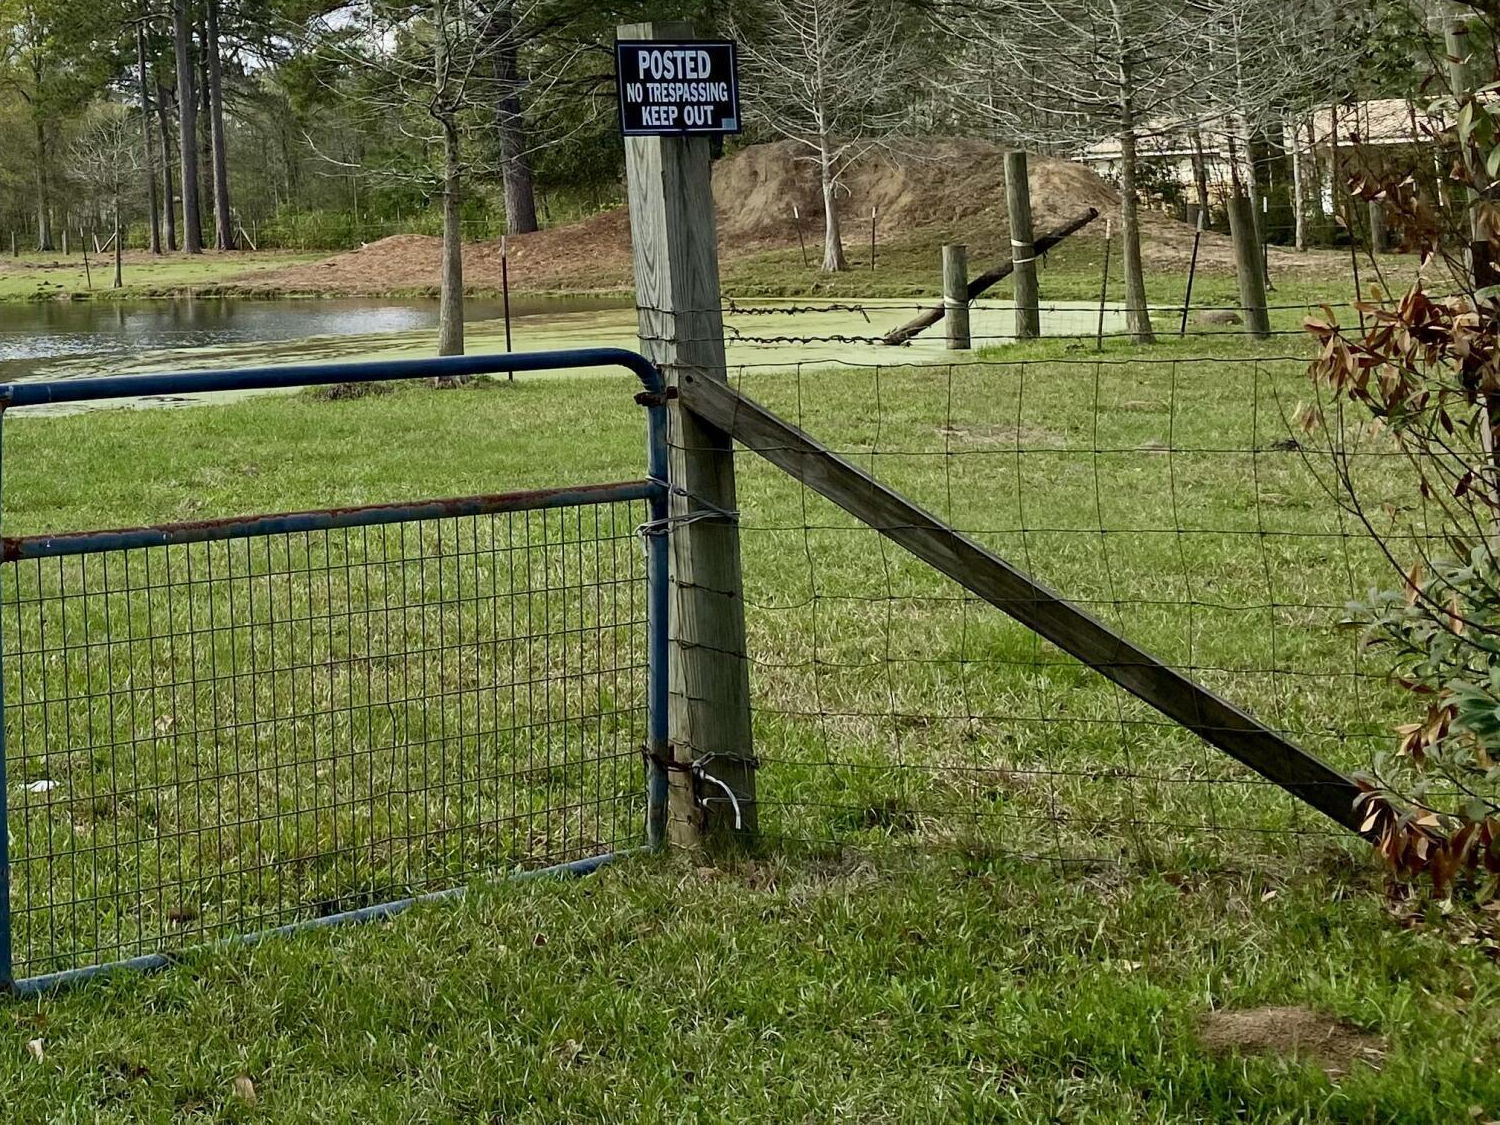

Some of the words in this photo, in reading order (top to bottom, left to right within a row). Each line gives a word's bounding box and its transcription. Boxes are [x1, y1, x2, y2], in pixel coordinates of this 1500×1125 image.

[638, 50, 711, 79] POSTED
[626, 82, 643, 102] NO
[646, 82, 728, 102] TRESPASSING
[641, 106, 678, 126] KEEP
[683, 105, 714, 125] OUT
